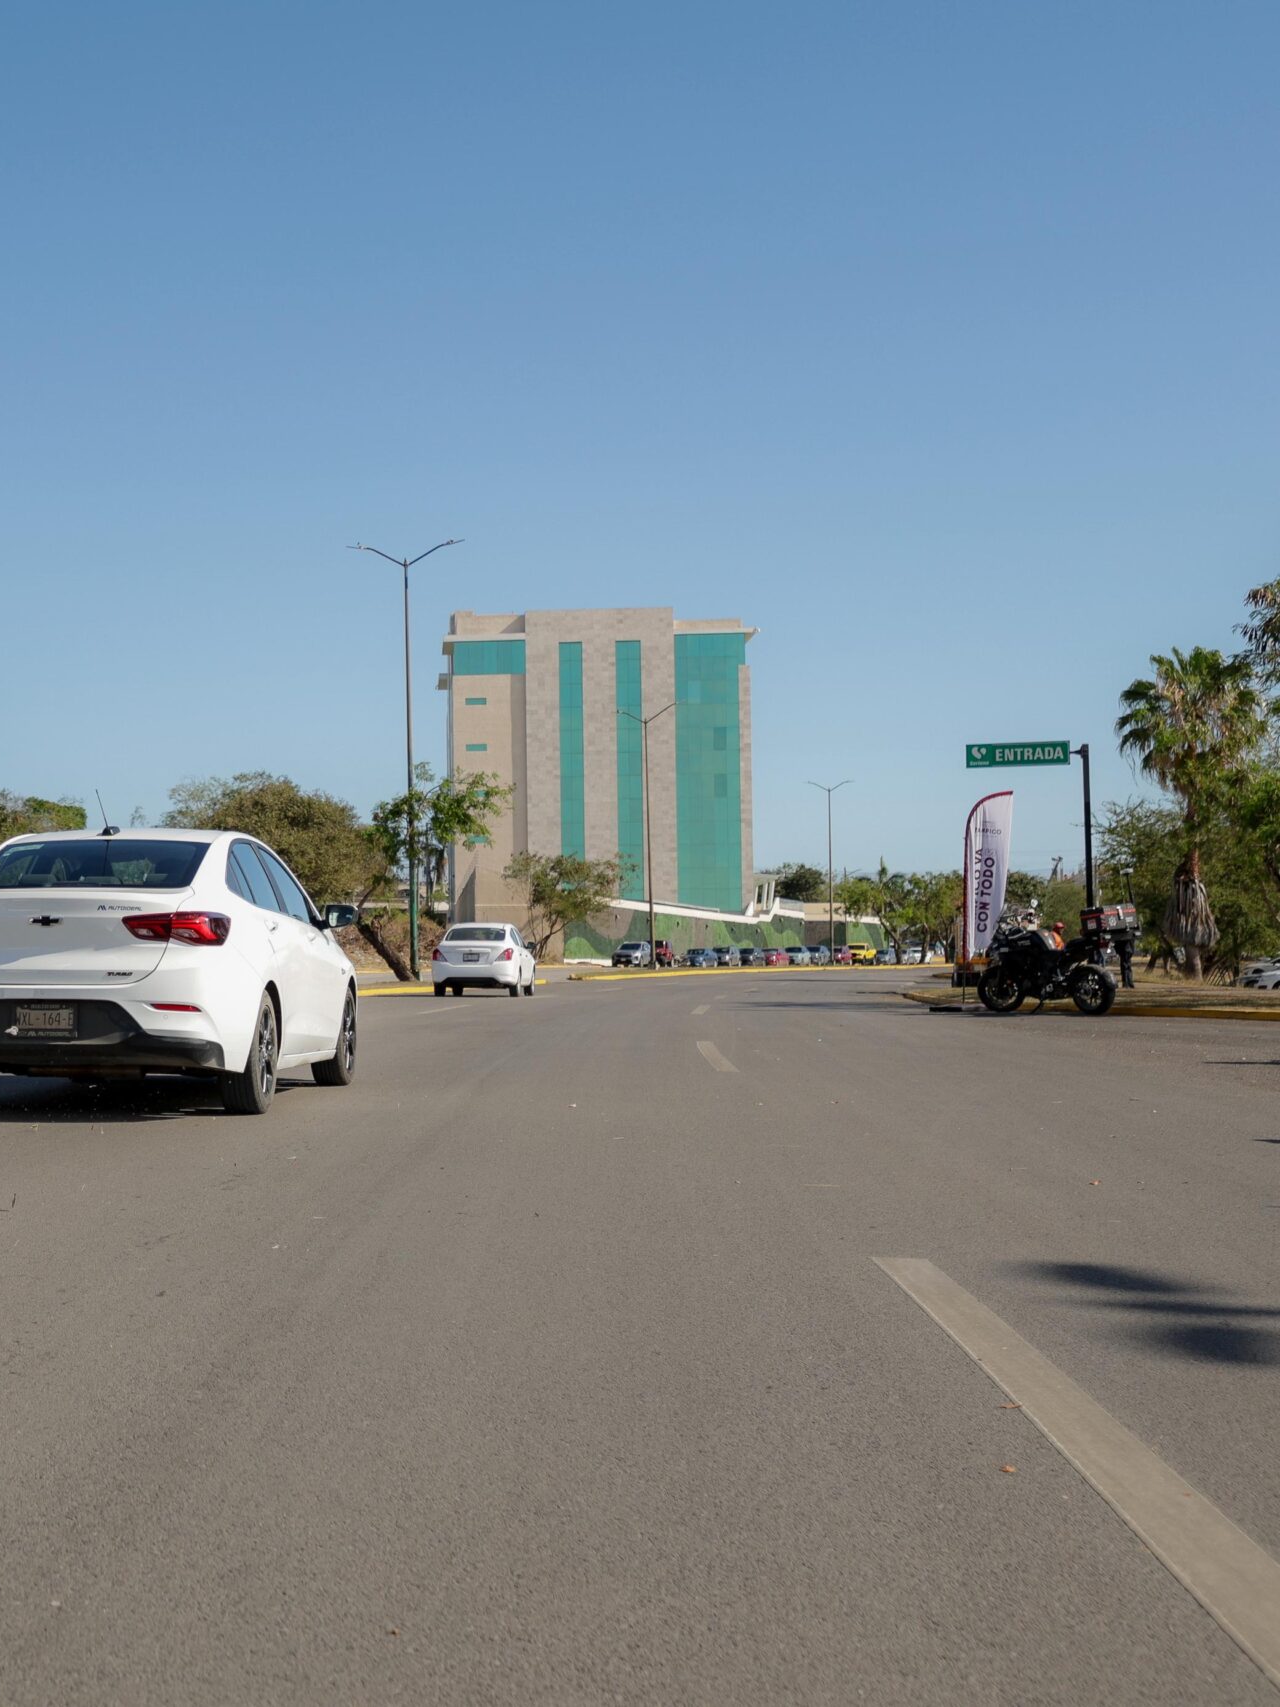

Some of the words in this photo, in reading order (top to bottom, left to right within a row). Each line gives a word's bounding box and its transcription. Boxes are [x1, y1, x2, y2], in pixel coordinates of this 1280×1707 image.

[995, 746, 1064, 762] ENTRADA
[980, 857, 995, 897] TODO
[976, 901, 990, 933] CON
